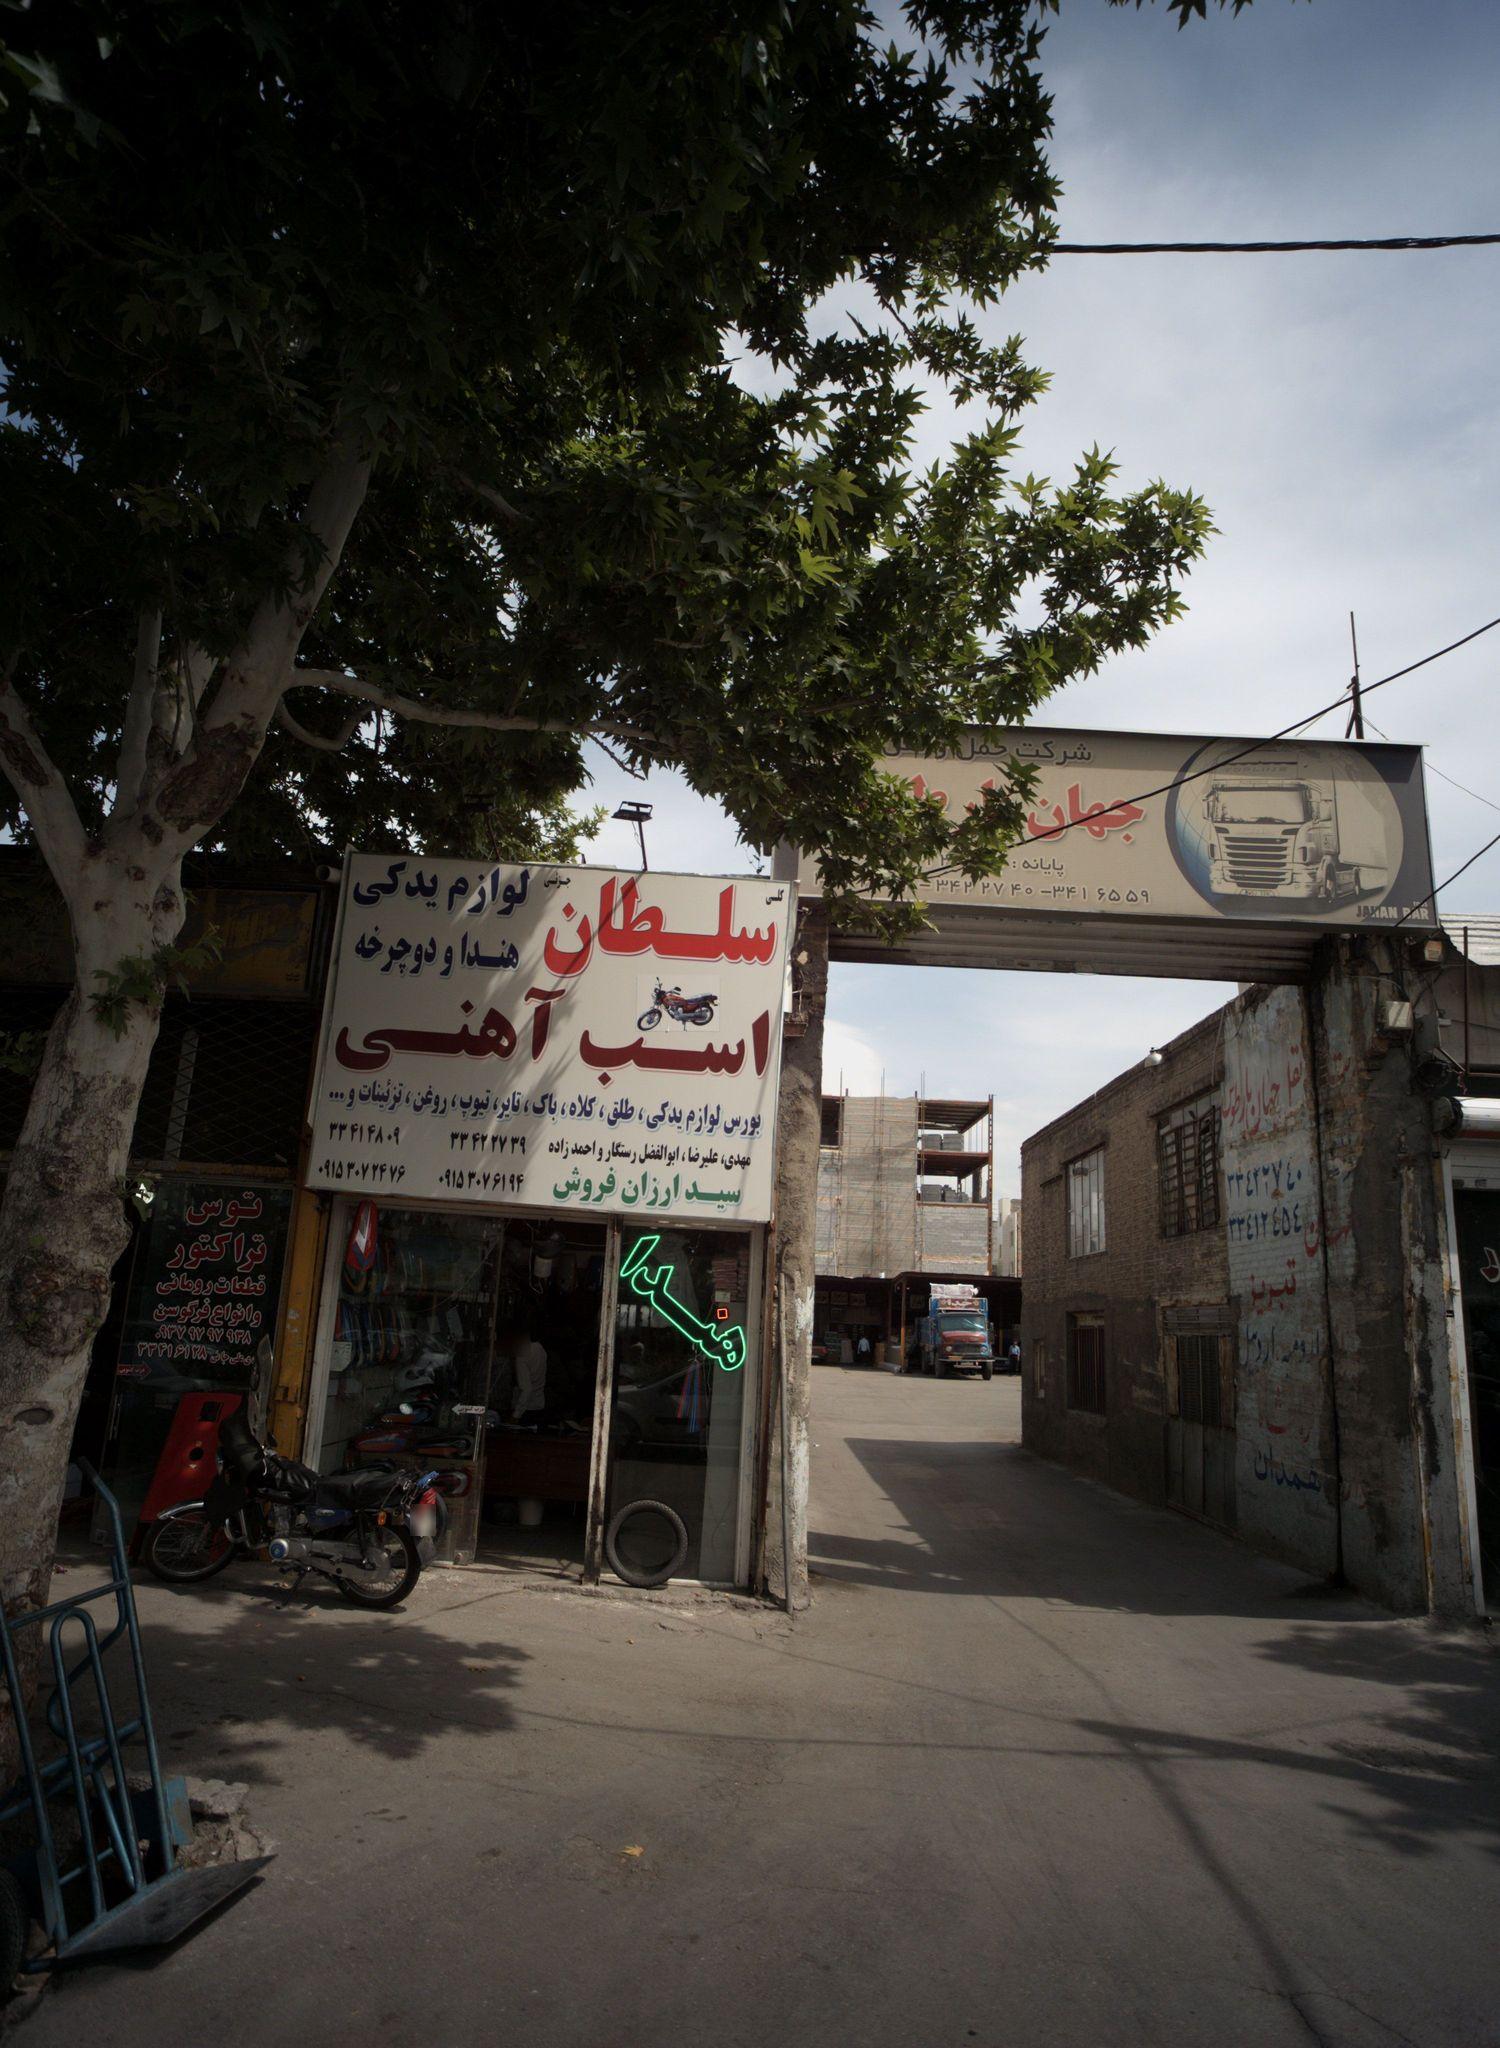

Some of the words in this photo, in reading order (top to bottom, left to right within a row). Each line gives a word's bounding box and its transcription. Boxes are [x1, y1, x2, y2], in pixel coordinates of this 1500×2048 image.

[1016, 741, 1092, 765] شرکت
[1027, 783, 1144, 843] جهان
[353, 861, 439, 908] یدکی
[447, 867, 531, 916] لوازم
[543, 875, 778, 978] سلطان
[1356, 905, 1398, 919] JAHAN
[1402, 907, 1430, 920] BAR
[354, 926, 438, 975] دوچرخه
[439, 945, 454, 977] و
[461, 931, 520, 970] هندا
[334, 986, 567, 1073] آهنی
[579, 1010, 770, 1088] اسب
[686, 1104, 721, 1133] لوازم
[723, 1113, 762, 1136] بورس
[597, 1147, 603, 1162] و
[605, 1141, 637, 1163] رستگار
[638, 1143, 680, 1166] ابوالفضل
[553, 1167, 617, 1202] فروش
[621, 1171, 681, 1207] ارزان
[685, 1178, 741, 1209] سید
[186, 1191, 263, 1227] توس
[166, 1232, 267, 1273] تراکتور
[156, 1272, 214, 1295] رومانی
[214, 1275, 267, 1295] قطعات
[1250, 1257, 1296, 1316] تبریز
[153, 1298, 211, 1324] فرگوسن
